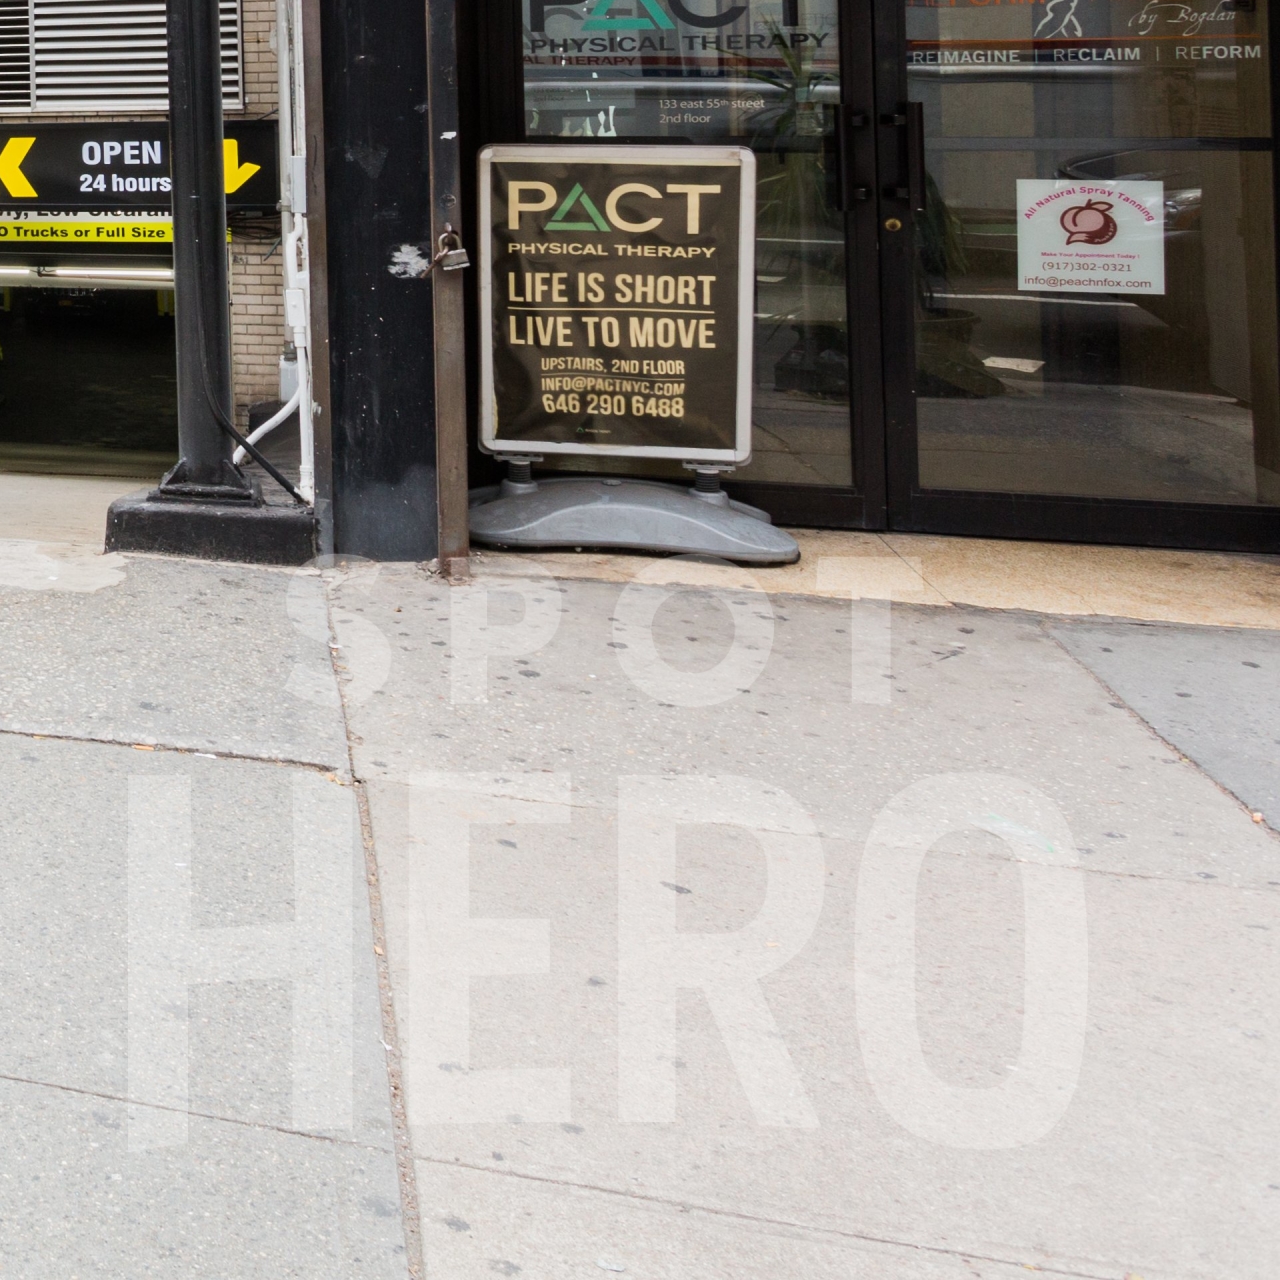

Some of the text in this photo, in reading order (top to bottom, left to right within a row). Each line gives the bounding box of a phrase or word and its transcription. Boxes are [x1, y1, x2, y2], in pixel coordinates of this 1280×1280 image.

[1136, 0, 1159, 36] by
[531, 32, 829, 54] PHYSICAL THERAPY
[913, 45, 1261, 64] REIMAGINE RECLAIM REFORM
[659, 97, 766, 109] 133 east 55th street
[659, 112, 711, 124] 2nd floor
[82, 141, 162, 165] OPEN
[79, 173, 172, 192] 24 hours
[507, 180, 721, 235] PACT
[1024, 186, 1155, 222] All Natural Spray Tanning
[13, 226, 69, 238] Trucks
[74, 229, 91, 238] or
[96, 226, 126, 238] Full
[132, 227, 166, 238] Size
[508, 242, 716, 259] PHYSICAL THERAPY
[1042, 261, 1132, 273] (917)302-0321
[508, 272, 716, 306] LIFE IS SHORT
[1024, 276, 1152, 289] info@peachnfox.com
[509, 315, 716, 349] LIVE TO MOVE
[541, 357, 685, 375] UPSTAIRS, 2ND FLOOR
[541, 377, 685, 396] INFO@PACTNYC.COM
[542, 394, 580, 414] 646
[586, 395, 626, 416] 290
